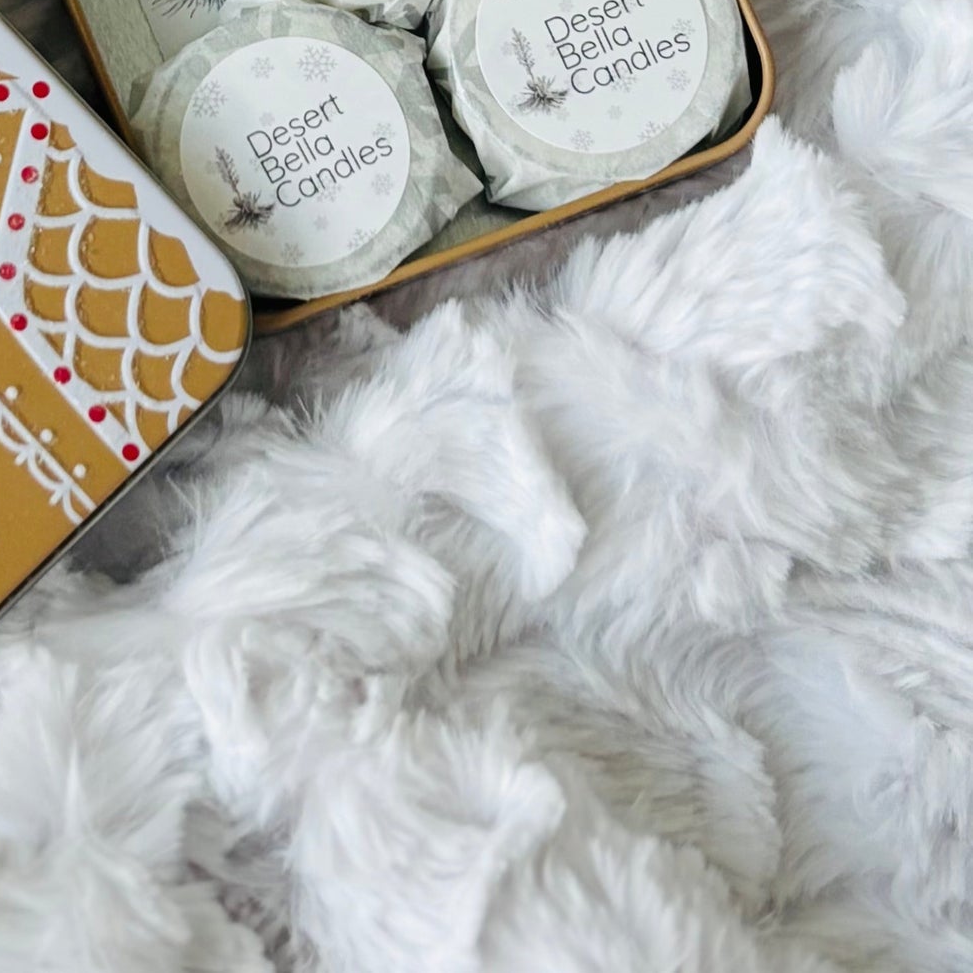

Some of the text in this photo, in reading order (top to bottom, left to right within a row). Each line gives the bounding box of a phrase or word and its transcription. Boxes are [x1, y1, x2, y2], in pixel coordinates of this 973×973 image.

[556, 26, 633, 70] Bella
[570, 33, 691, 94] Candles
[247, 94, 344, 159] Desert
[260, 135, 335, 184] Bella
[276, 137, 393, 207] Candles
